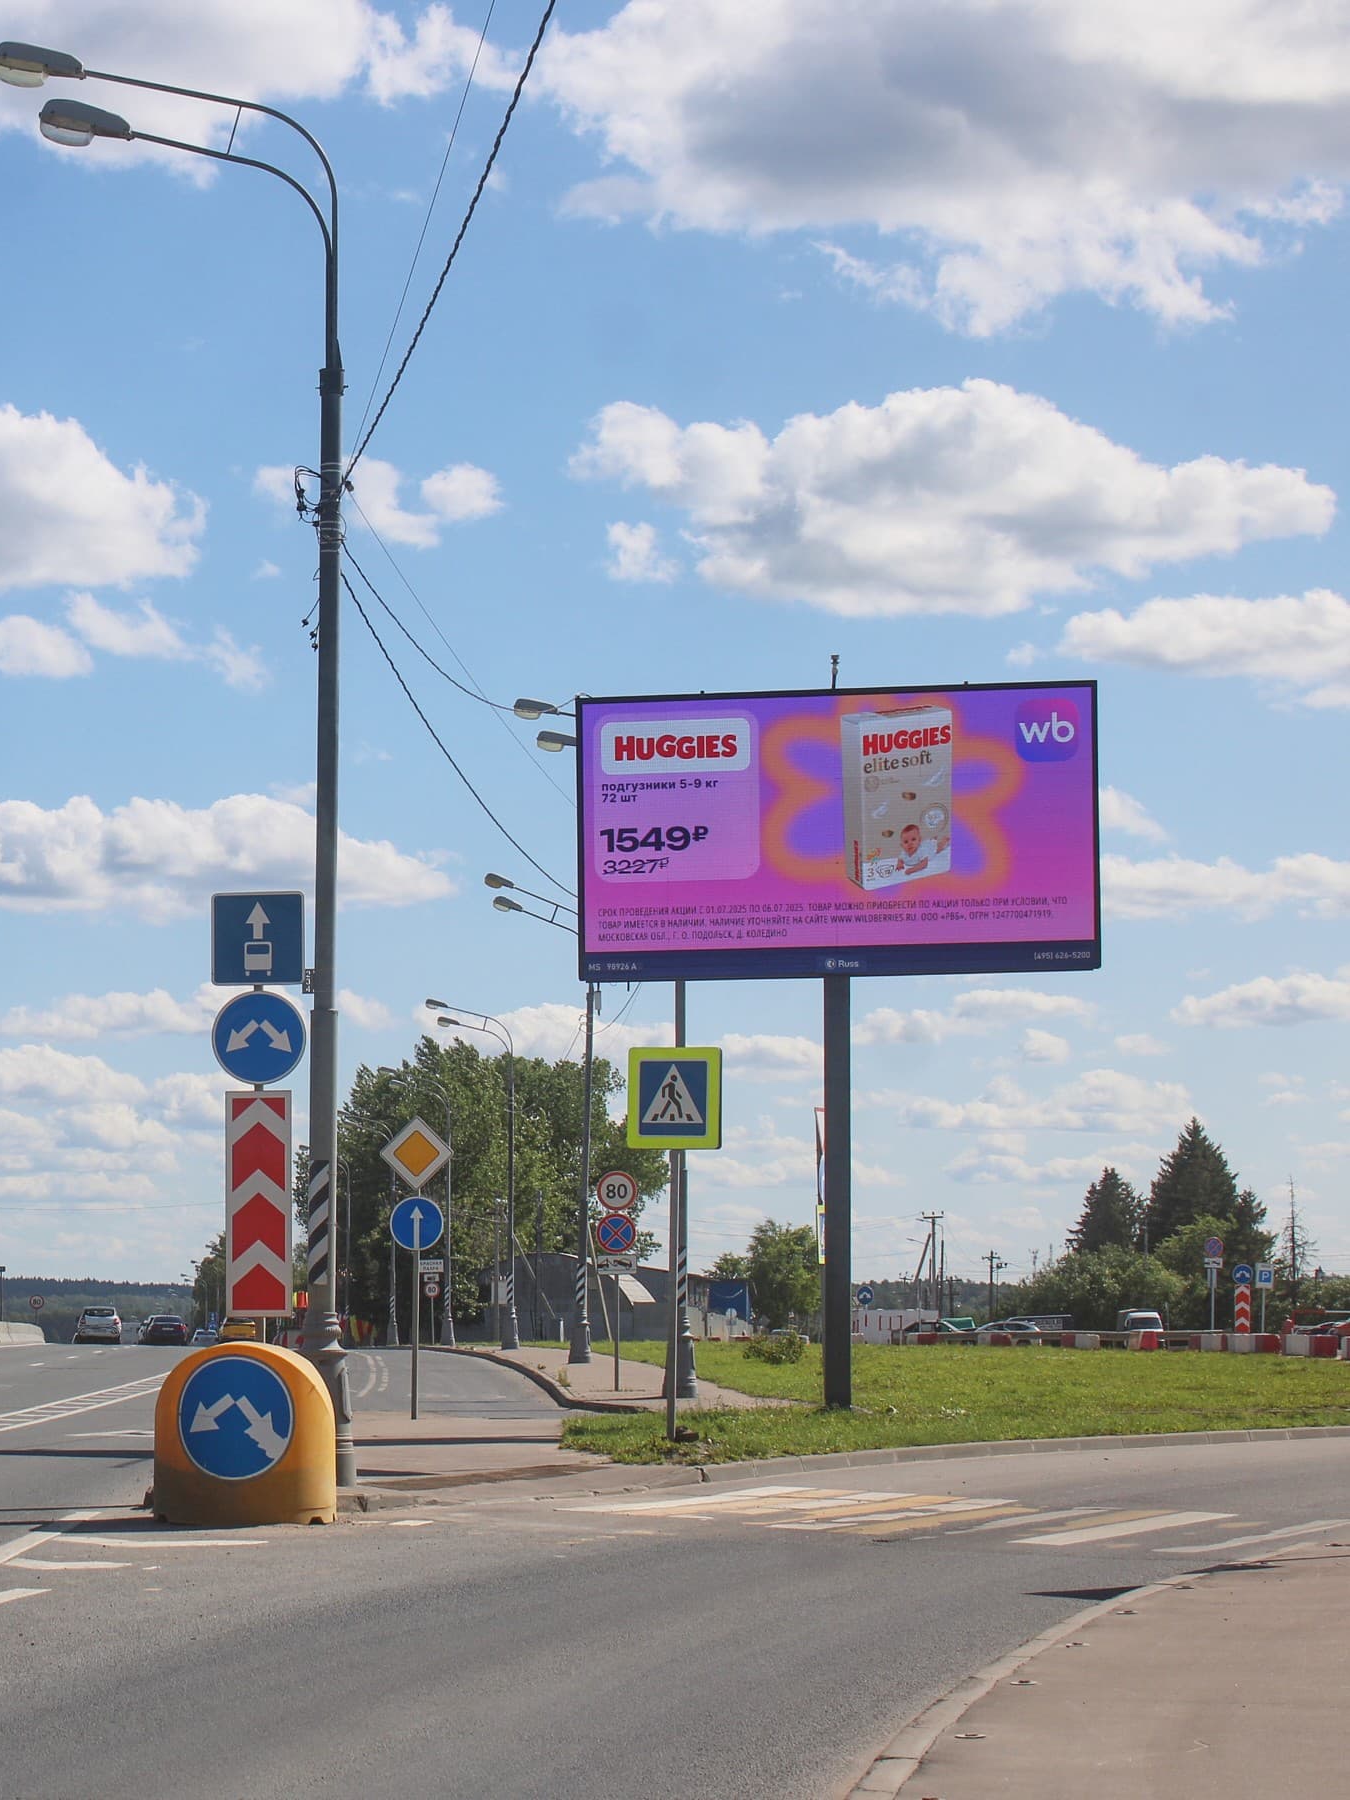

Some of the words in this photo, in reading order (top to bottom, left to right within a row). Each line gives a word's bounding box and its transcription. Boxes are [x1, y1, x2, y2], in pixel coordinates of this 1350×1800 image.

[1018, 711, 1075, 744] wb
[614, 734, 738, 761] HUGGIES
[862, 724, 952, 757] HUGGIES
[863, 756, 900, 774] elite
[901, 749, 933, 768] soft
[601, 781, 676, 793] подгузники
[679, 778, 702, 789] 5-9
[705, 779, 719, 788] кг
[601, 793, 617, 803] 72
[620, 794, 638, 803] шт
[598, 907, 618, 917] СРОК
[619, 906, 669, 917] ПРОВЕДЕНИЯ
[671, 905, 697, 916] АКЦИИ
[749, 904, 760, 913] ПО
[808, 902, 832, 912] ТОВАР
[834, 902, 864, 911] МОЖНО
[866, 900, 916, 910] ПРИОБРЕСТИ
[918, 899, 930, 908] ПО
[931, 898, 959, 909] АКЦИИ
[961, 898, 990, 908] ТОЛЬКО
[992, 897, 1009, 906] ПРИ
[1052, 895, 1068, 905] ЧТО
[598, 920, 622, 930] ТОВАР
[623, 919, 658, 929] ИМЕЕТСЯ
[660, 919, 666, 928] В
[709, 917, 745, 927] НАЛИЧИЕ
[747, 915, 790, 926] УТОЧНЯЙТЕ
[792, 915, 803, 924] НА
[804, 914, 828, 924] САЙТЕ
[920, 912, 938, 921] ООО
[969, 910, 989, 920] ОГРН
[598, 932, 648, 942] МОСКОВСКАЯ
[746, 928, 787, 939] КОЛЕДИНО
[838, 959, 859, 968] Russ
[1034, 951, 1053, 960] (495)
[606, 1183, 628, 1199] 80
[1261, 1271, 1270, 1281] P
